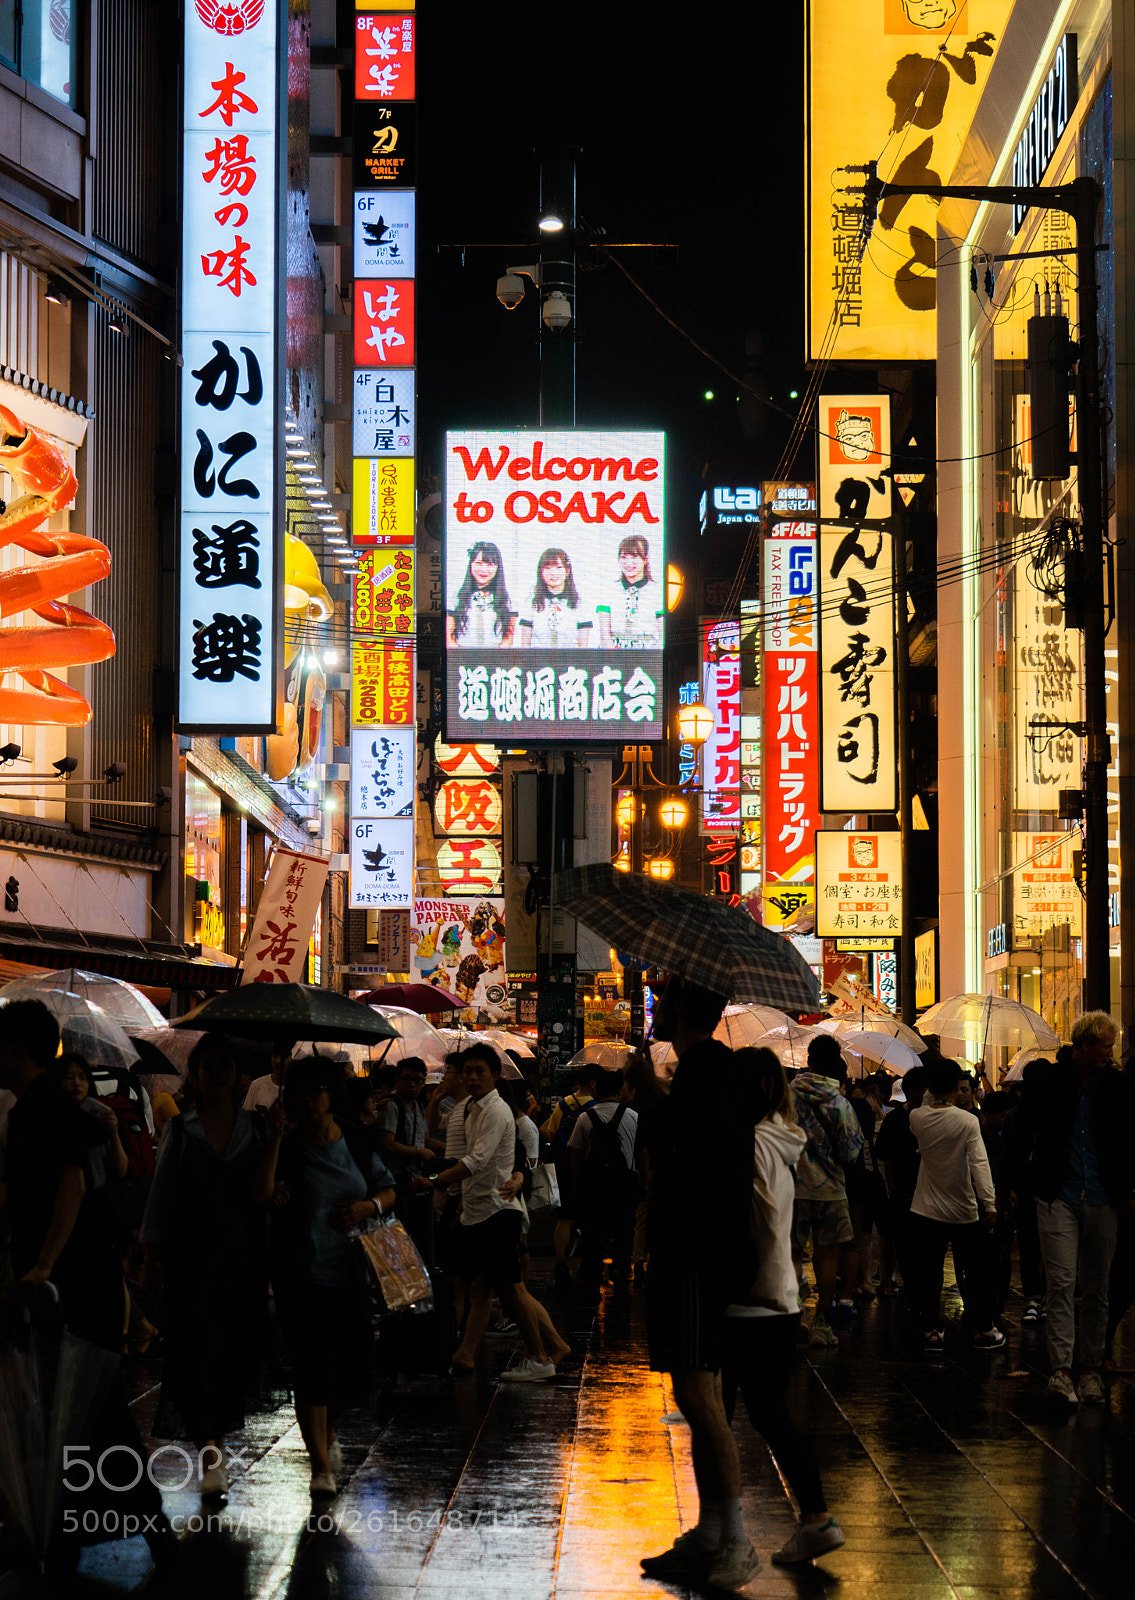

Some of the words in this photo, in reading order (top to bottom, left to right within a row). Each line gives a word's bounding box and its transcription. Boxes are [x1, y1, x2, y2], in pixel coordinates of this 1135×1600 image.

[357, 17, 373, 30] 8F
[379, 108, 392, 119] 7F
[1012, 68, 1055, 236] FOREVER
[198, 61, 259, 298] 本場の味
[358, 197, 375, 210] 6F
[363, 284, 405, 361] はや
[356, 374, 371, 385] 4F
[373, 377, 410, 450] 白木屋
[453, 441, 658, 481] Welcome
[380, 464, 398, 530] 鳥貴族
[453, 492, 494, 524] to
[504, 490, 660, 524] OSAKA
[717, 513, 742, 524] Japan
[376, 535, 391, 543] 3F
[771, 547, 782, 571] TAX
[394, 551, 413, 632] たこやき
[771, 575, 782, 608] FREE
[771, 611, 782, 647] SHOP
[360, 686, 376, 719] 280
[458, 666, 656, 722] 道頓堀商店会
[776, 658, 810, 853] ツルハドラッグ
[355, 824, 373, 838] 6F
[413, 901, 470, 912] MONSTER
[832, 914, 900, 929] 寿司・和食
